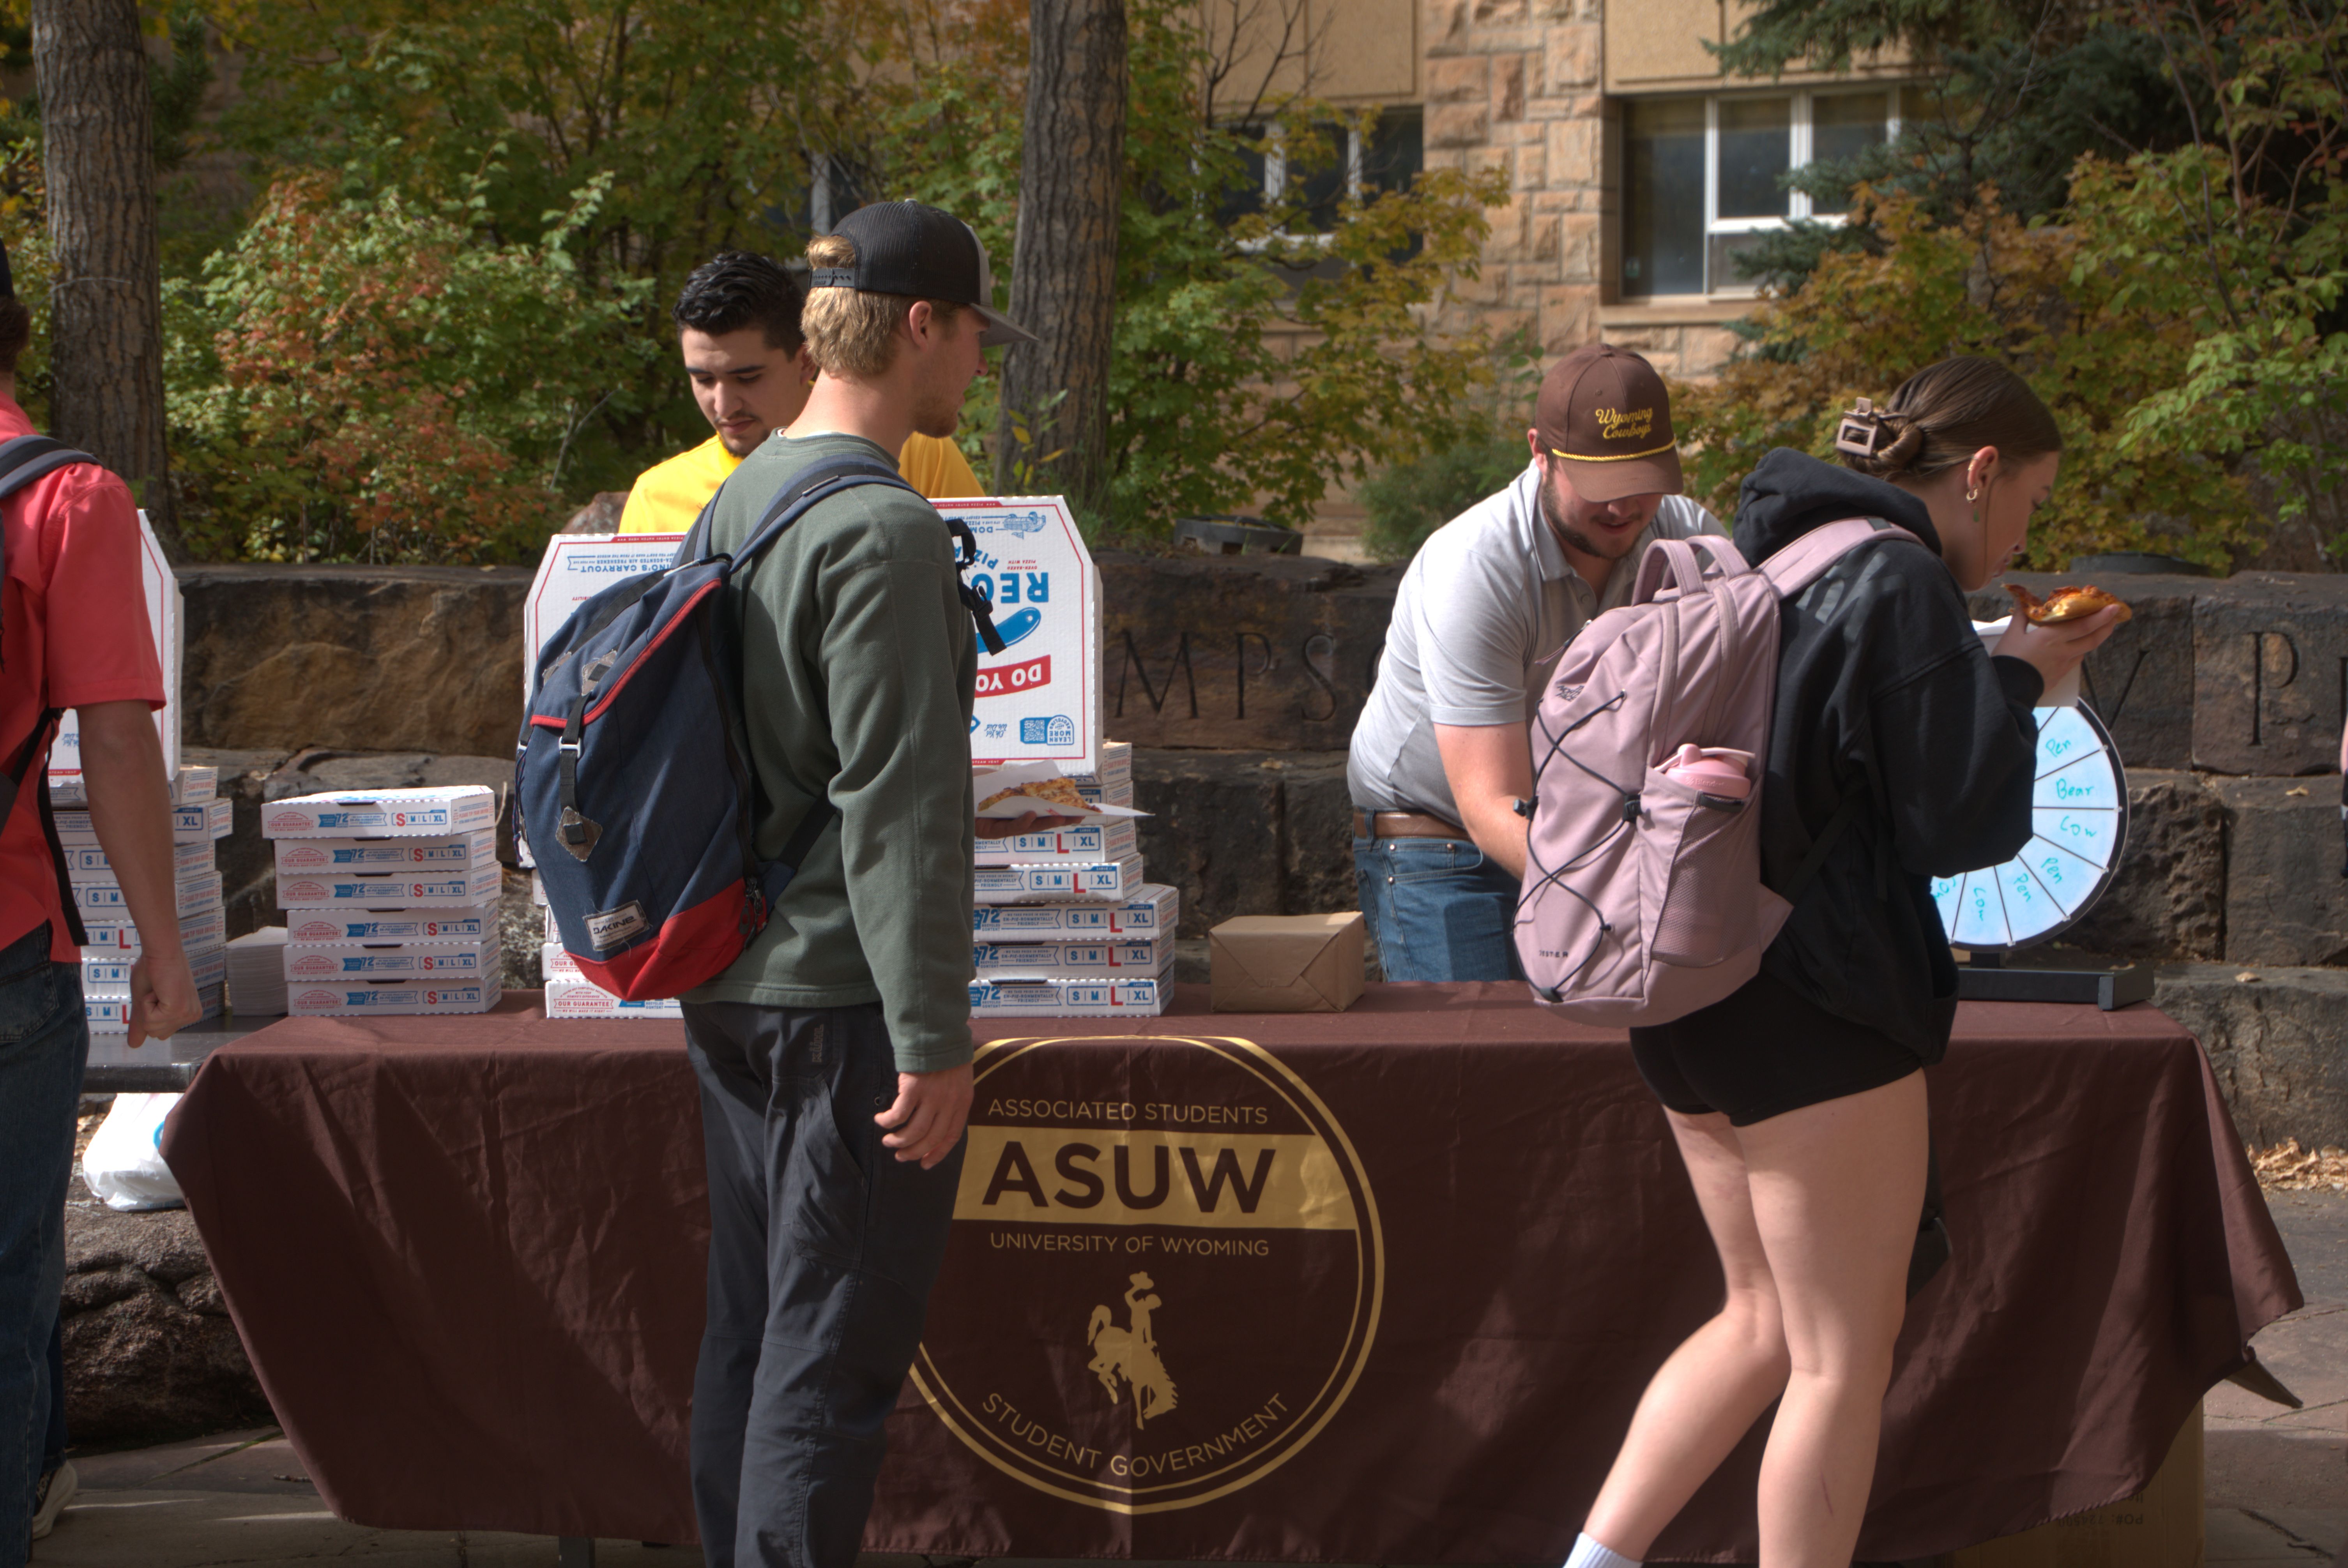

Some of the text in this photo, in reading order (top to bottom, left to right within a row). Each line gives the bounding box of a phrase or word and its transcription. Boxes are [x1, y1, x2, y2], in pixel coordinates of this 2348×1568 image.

[1596, 407, 1653, 429] Wyoming
[1603, 422, 1651, 439] Cowboys
[580, 565, 637, 573] CARRYOUT
[975, 663, 1041, 692] DO YO
[2045, 738, 2071, 758] Pen
[2055, 778, 2094, 800] Bear
[182, 816, 198, 826] XL
[396, 813, 406, 826] S
[2059, 816, 2097, 839] Cow
[1020, 833, 1095, 854] S M L XL
[85, 855, 93, 865] S
[414, 848, 424, 862] S
[2041, 857, 2062, 885] Pen
[414, 883, 423, 897] S
[1036, 873, 1112, 893] S M L XL
[2013, 873, 2032, 902] Pen
[92, 892, 118, 902] S M
[428, 922, 437, 936] S
[1072, 913, 1148, 933] S M L XL
[100, 929, 131, 949] M L
[424, 957, 433, 970] S
[1071, 946, 1147, 967] S M L XL
[94, 968, 119, 978] S M
[428, 991, 437, 1005] S
[1073, 986, 1149, 1006] S M L XL
[85, 1007, 92, 1016] S
[103, 1006, 111, 1016] M
[988, 1098, 1268, 1125] ASSOCIATED STUDENTS
[981, 1140, 1276, 1214] ASUW
[990, 1231, 1269, 1256] UNIVERSITY OF WYOMING
[982, 1392, 1289, 1478] STUDENT GOVERNMENT
